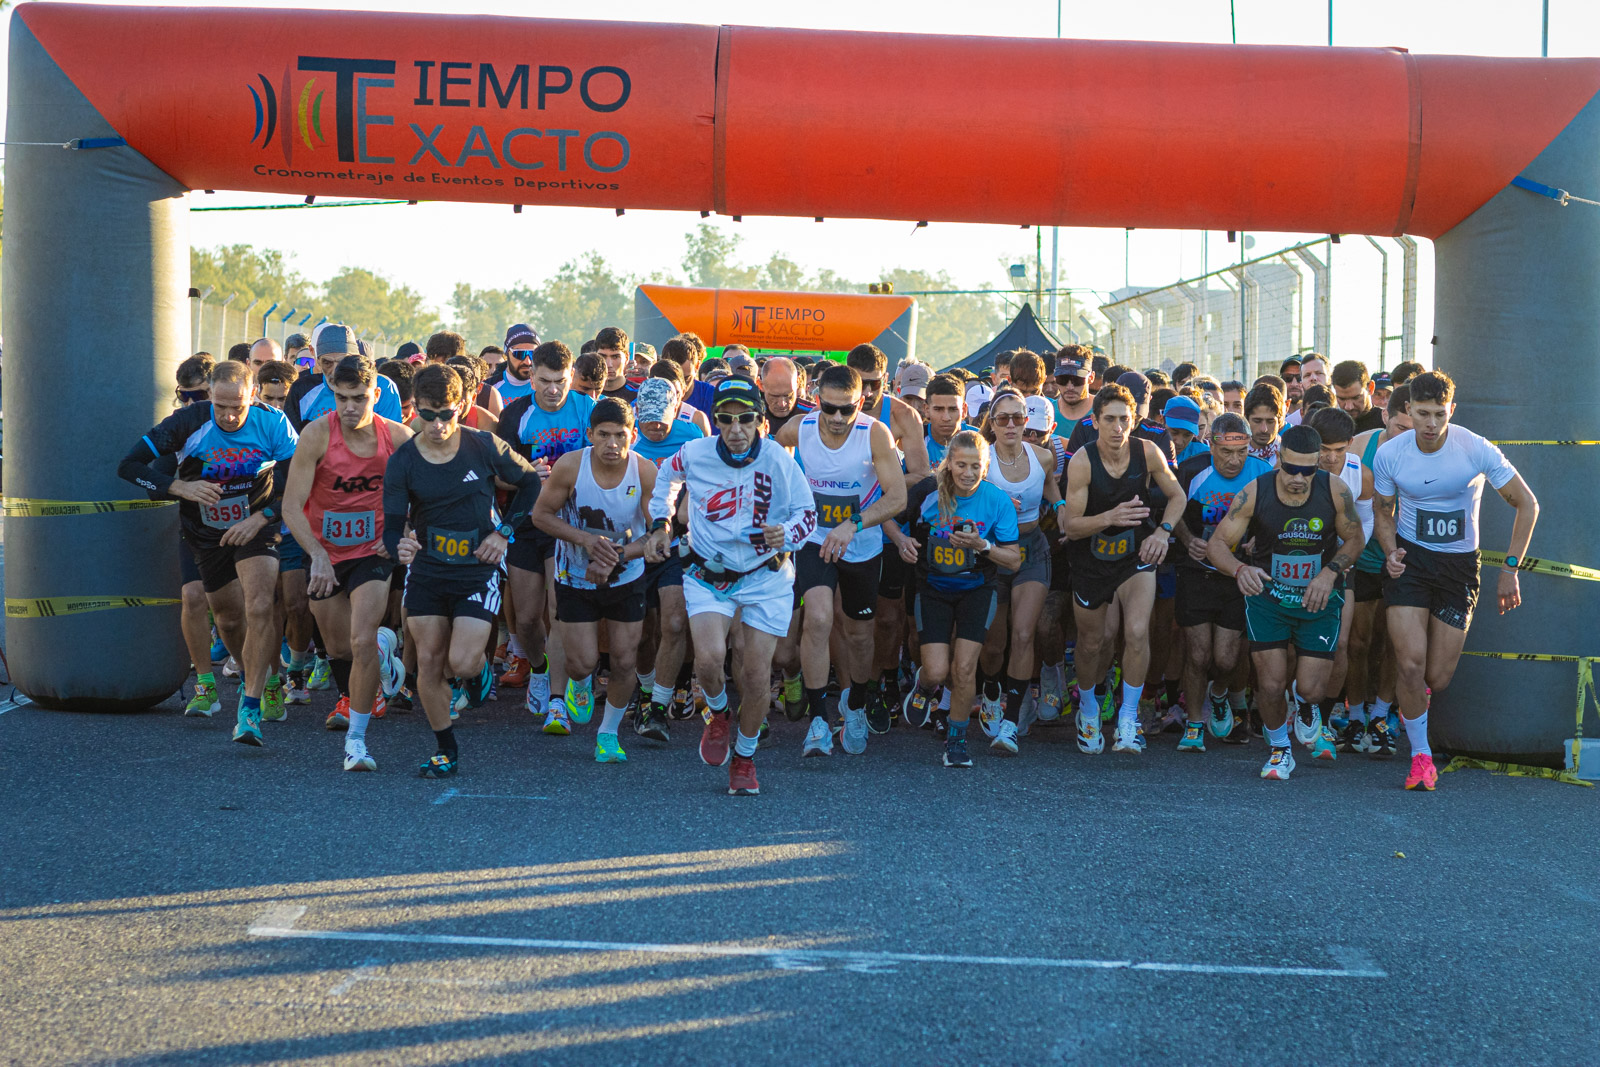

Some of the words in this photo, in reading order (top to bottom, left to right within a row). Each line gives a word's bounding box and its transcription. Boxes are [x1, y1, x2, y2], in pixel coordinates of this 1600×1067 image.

[253, 165, 394, 185] Cronometraje
[403, 171, 426, 183] de
[432, 173, 504, 187] Eventos
[514, 177, 620, 191] Deportivos
[332, 475, 383, 493] KRC
[809, 478, 861, 489] RUNNEA
[209, 504, 242, 522] 359
[822, 504, 852, 523] 744
[331, 519, 365, 538] 313
[1312, 519, 1320, 530] 3
[1427, 518, 1457, 537] 106
[1278, 531, 1322, 540] EGUSQUIZA
[435, 535, 469, 557] 706
[1097, 538, 1127, 555] 718
[934, 546, 965, 566] 650
[1281, 562, 1312, 580] 317
